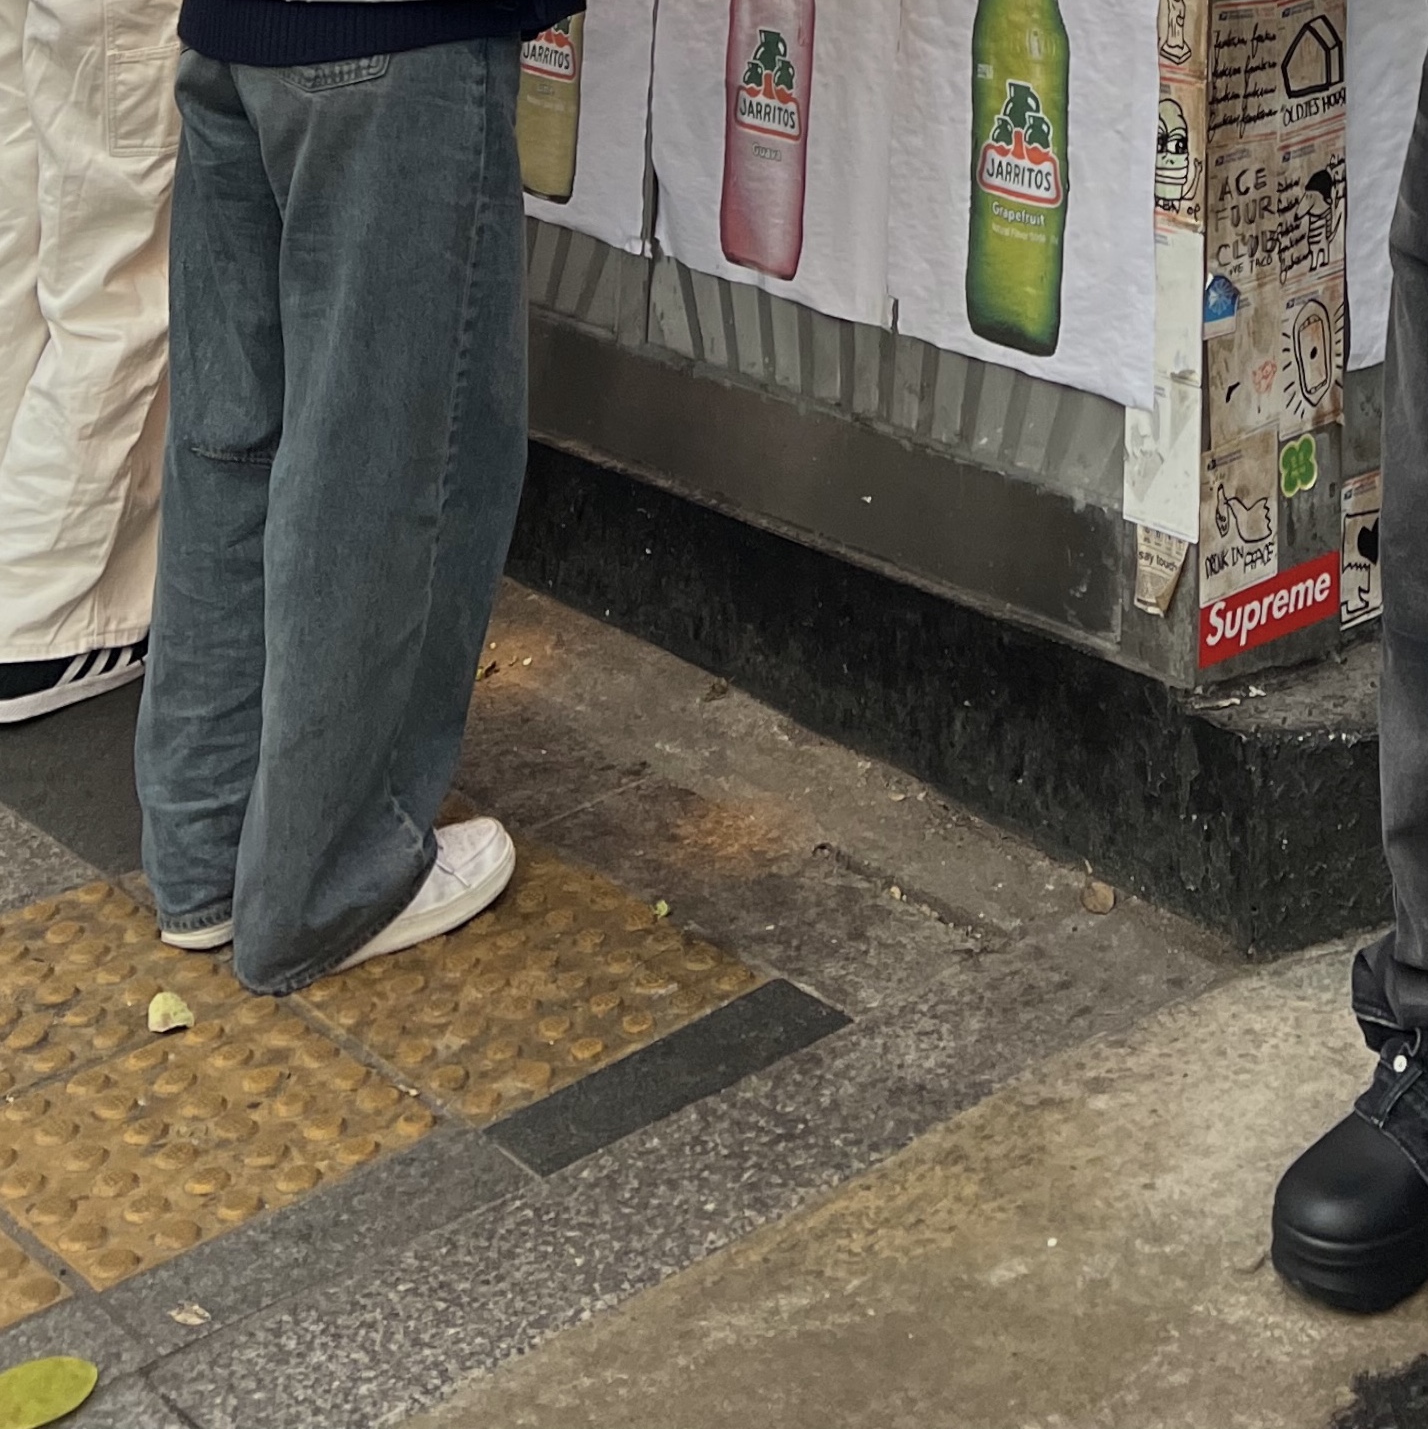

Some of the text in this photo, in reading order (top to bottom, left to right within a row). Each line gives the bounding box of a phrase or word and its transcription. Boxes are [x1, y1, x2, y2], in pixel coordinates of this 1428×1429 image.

[523, 42, 571, 70] JARRITOS
[739, 98, 796, 130] JARRITOS
[986, 158, 1052, 192] JARRITOS
[1218, 167, 1268, 202] ACE
[992, 200, 1045, 227] Grapefruit
[1214, 195, 1276, 233] FOUR
[1216, 230, 1281, 268] CLUB
[1138, 549, 1178, 572] say touch
[1231, 545, 1244, 567] IN
[1205, 572, 1332, 647] Supreme
